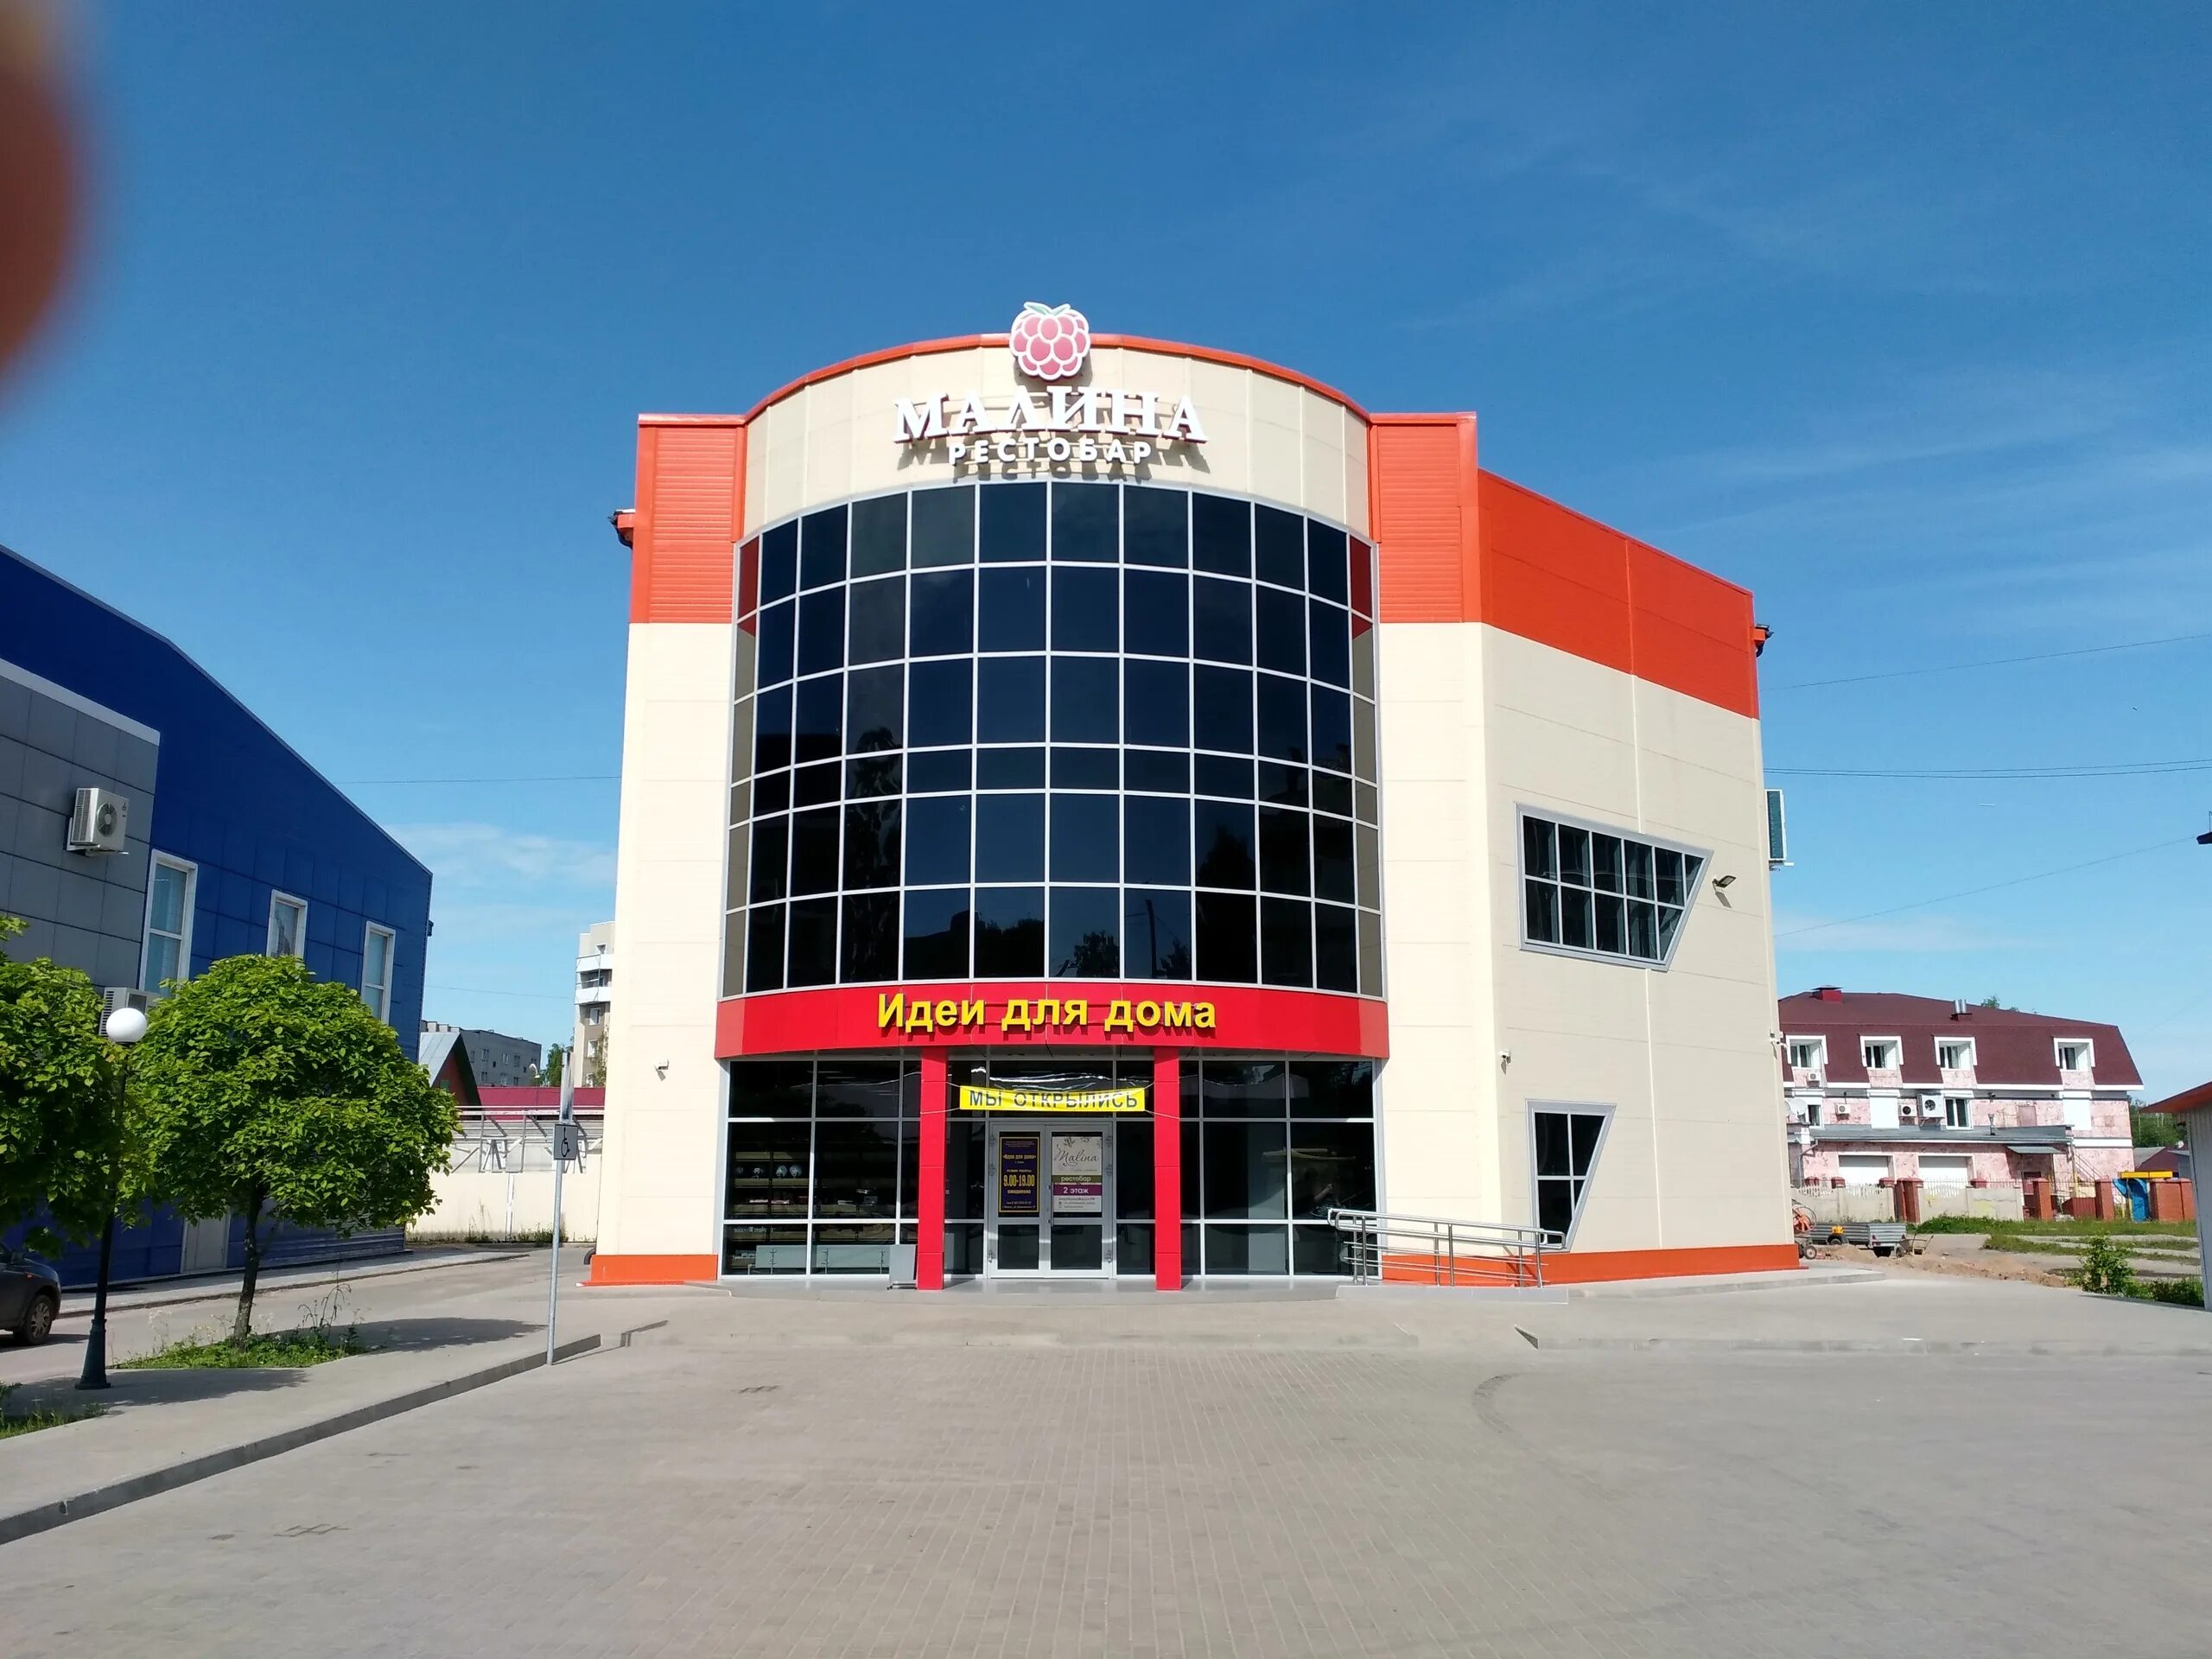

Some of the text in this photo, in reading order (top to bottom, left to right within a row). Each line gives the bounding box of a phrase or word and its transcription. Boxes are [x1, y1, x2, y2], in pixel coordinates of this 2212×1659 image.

[893, 385, 1209, 443] МАЛИНА
[949, 437, 1153, 466] РЕСТОБАР
[877, 993, 1217, 1033] Идеи для дома
[969, 1089, 1138, 1108] МЫ ОТКРЫЛИСЬ
